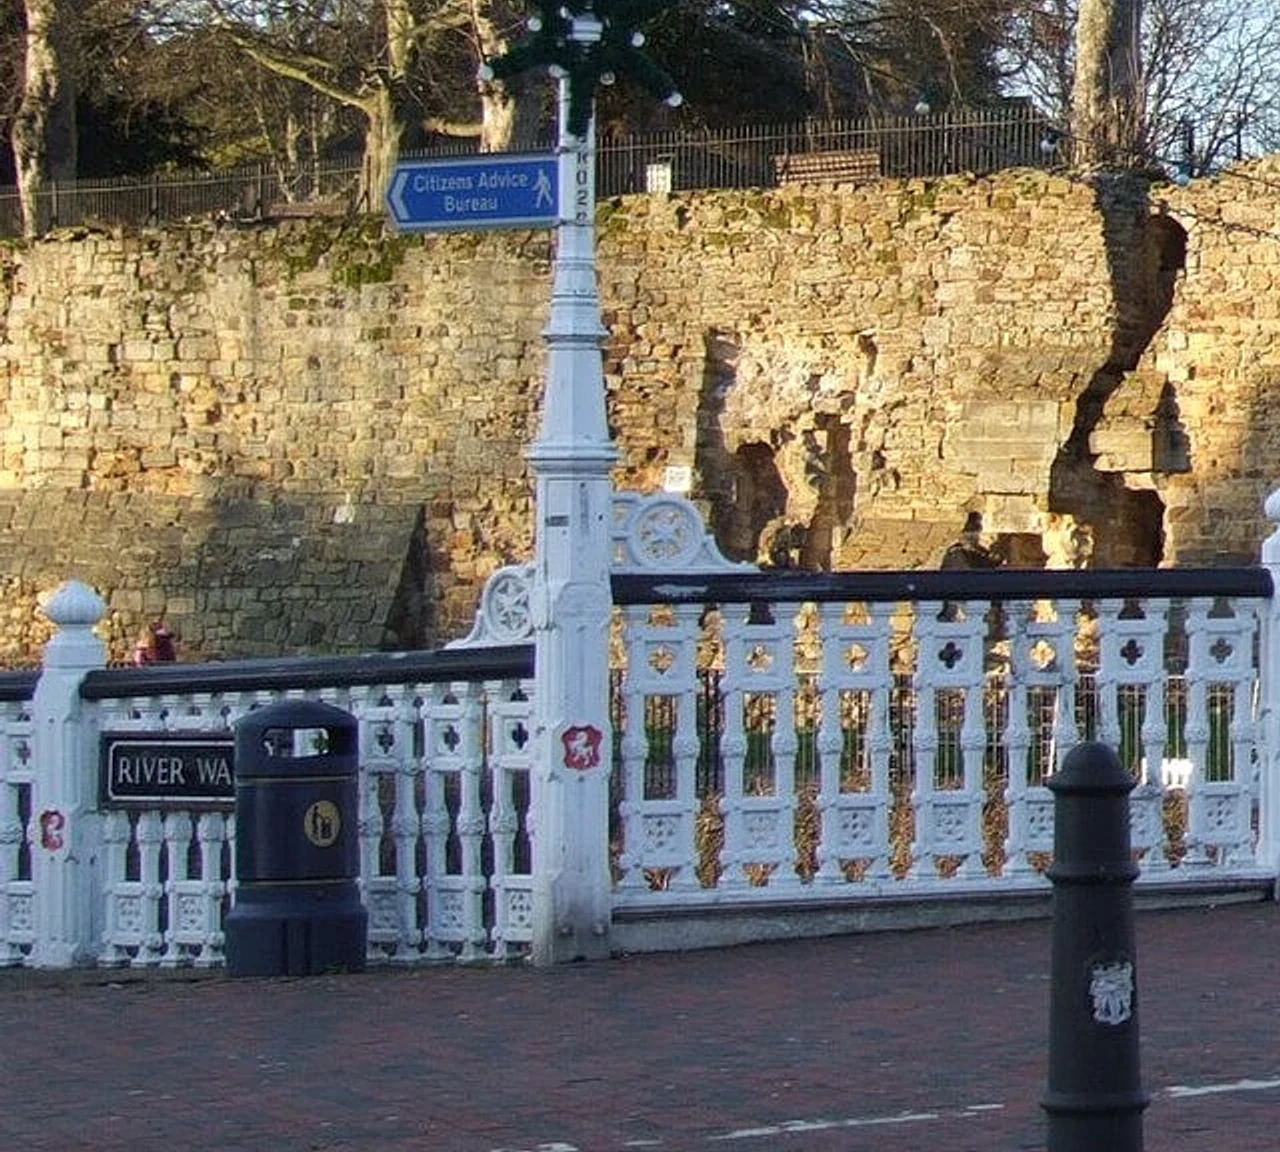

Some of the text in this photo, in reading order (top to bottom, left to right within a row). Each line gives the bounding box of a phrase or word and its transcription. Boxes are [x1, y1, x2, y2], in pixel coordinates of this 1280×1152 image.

[413, 171, 529, 193] Citizens Advice
[444, 195, 498, 212] Bureau
[118, 757, 186, 785] RIVER
